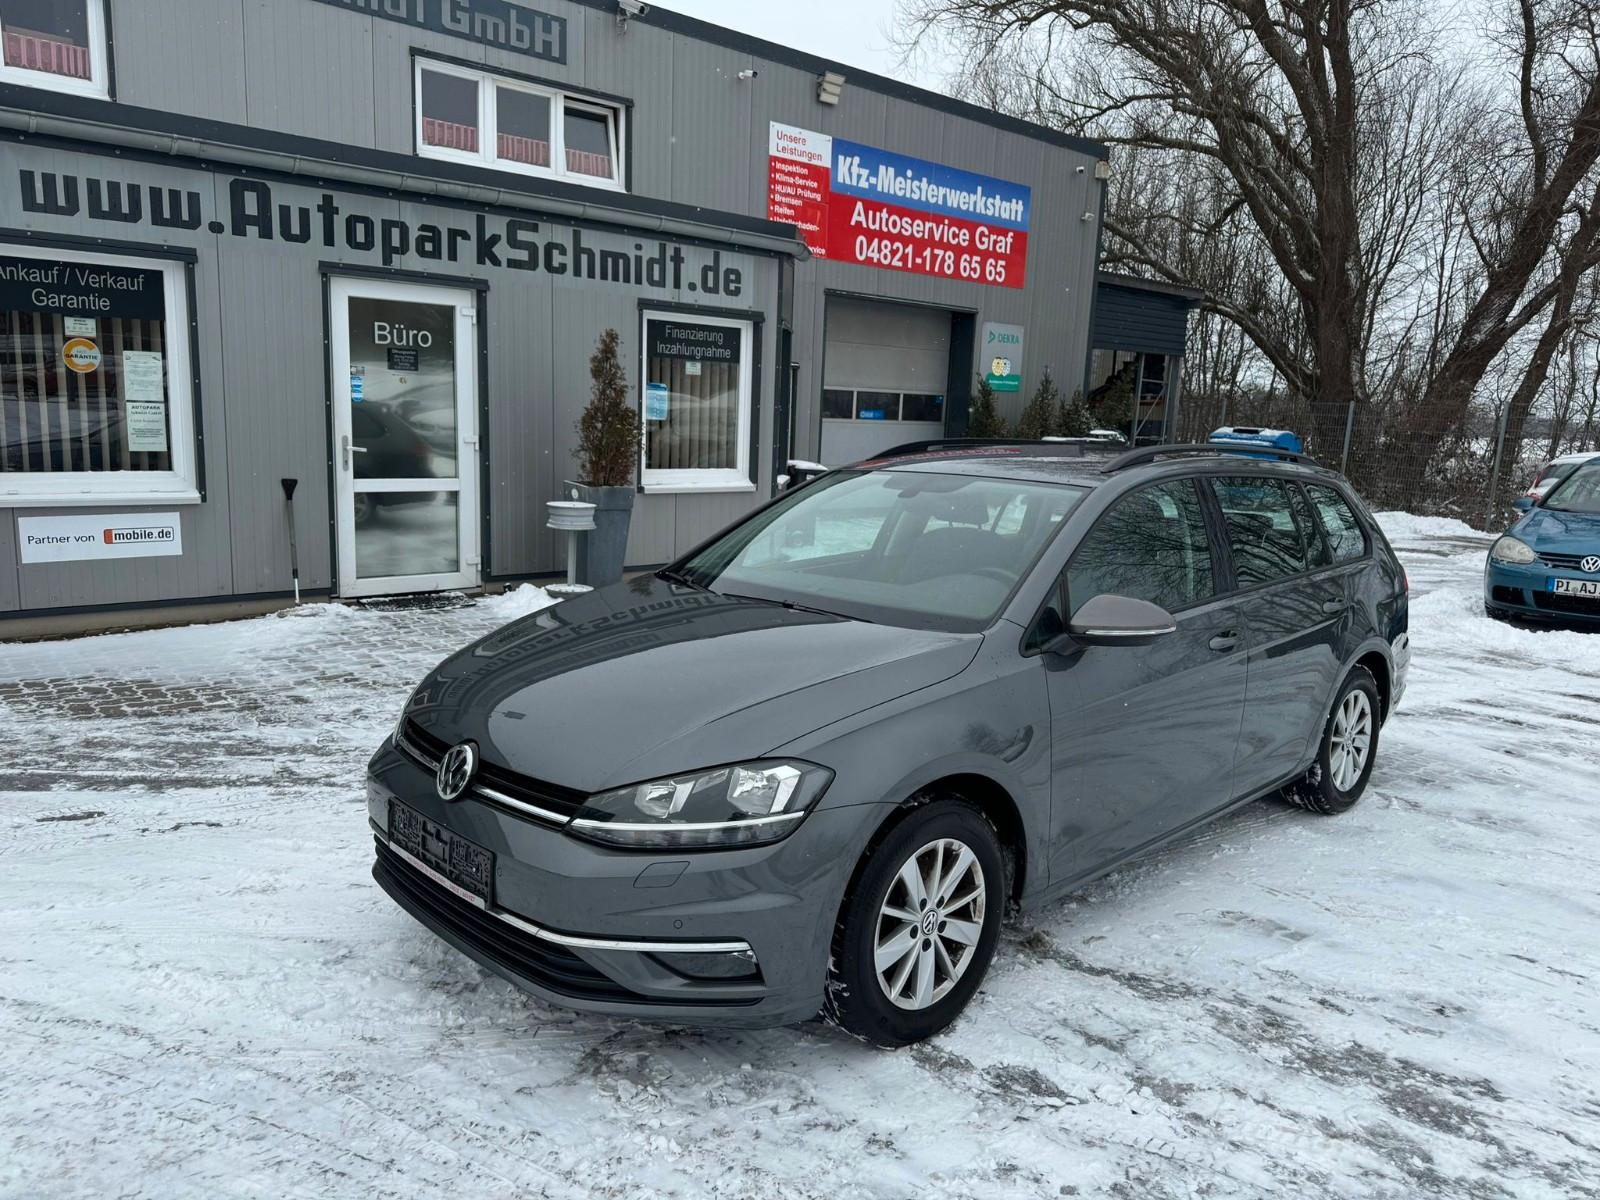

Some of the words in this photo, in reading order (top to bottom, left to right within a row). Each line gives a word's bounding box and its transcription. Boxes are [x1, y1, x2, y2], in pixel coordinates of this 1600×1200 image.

[441, 0, 560, 58] GmbH
[776, 130, 806, 146] Unsere
[776, 143, 823, 161] Leistungen
[775, 161, 808, 175] Inspektion
[775, 173, 818, 188] Klima-Service
[837, 155, 1024, 222] Kfz-Meisterwerkstatt
[775, 184, 796, 195] HU/AU
[797, 187, 822, 201] Prüfung
[775, 194, 803, 206] Bremsen
[774, 205, 795, 216] Reifen
[19, 168, 742, 297] www.AutoparkSchmidt.de
[850, 201, 970, 246] Autoservice
[975, 226, 1014, 254] Graf
[855, 235, 955, 275] 04821-178
[959, 254, 981, 279] 65
[985, 258, 1006, 283] 65
[75, 268, 145, 291] Verkauf
[32, 288, 111, 311] Garantie
[374, 321, 432, 348] Büro
[665, 325, 724, 345] Finanzierung
[657, 341, 731, 359] Inzahlungnahme
[27, 535, 71, 545] Partner
[71, 534, 95, 543] von
[114, 529, 171, 541] mobile.de
[1556, 580, 1570, 592] PI
